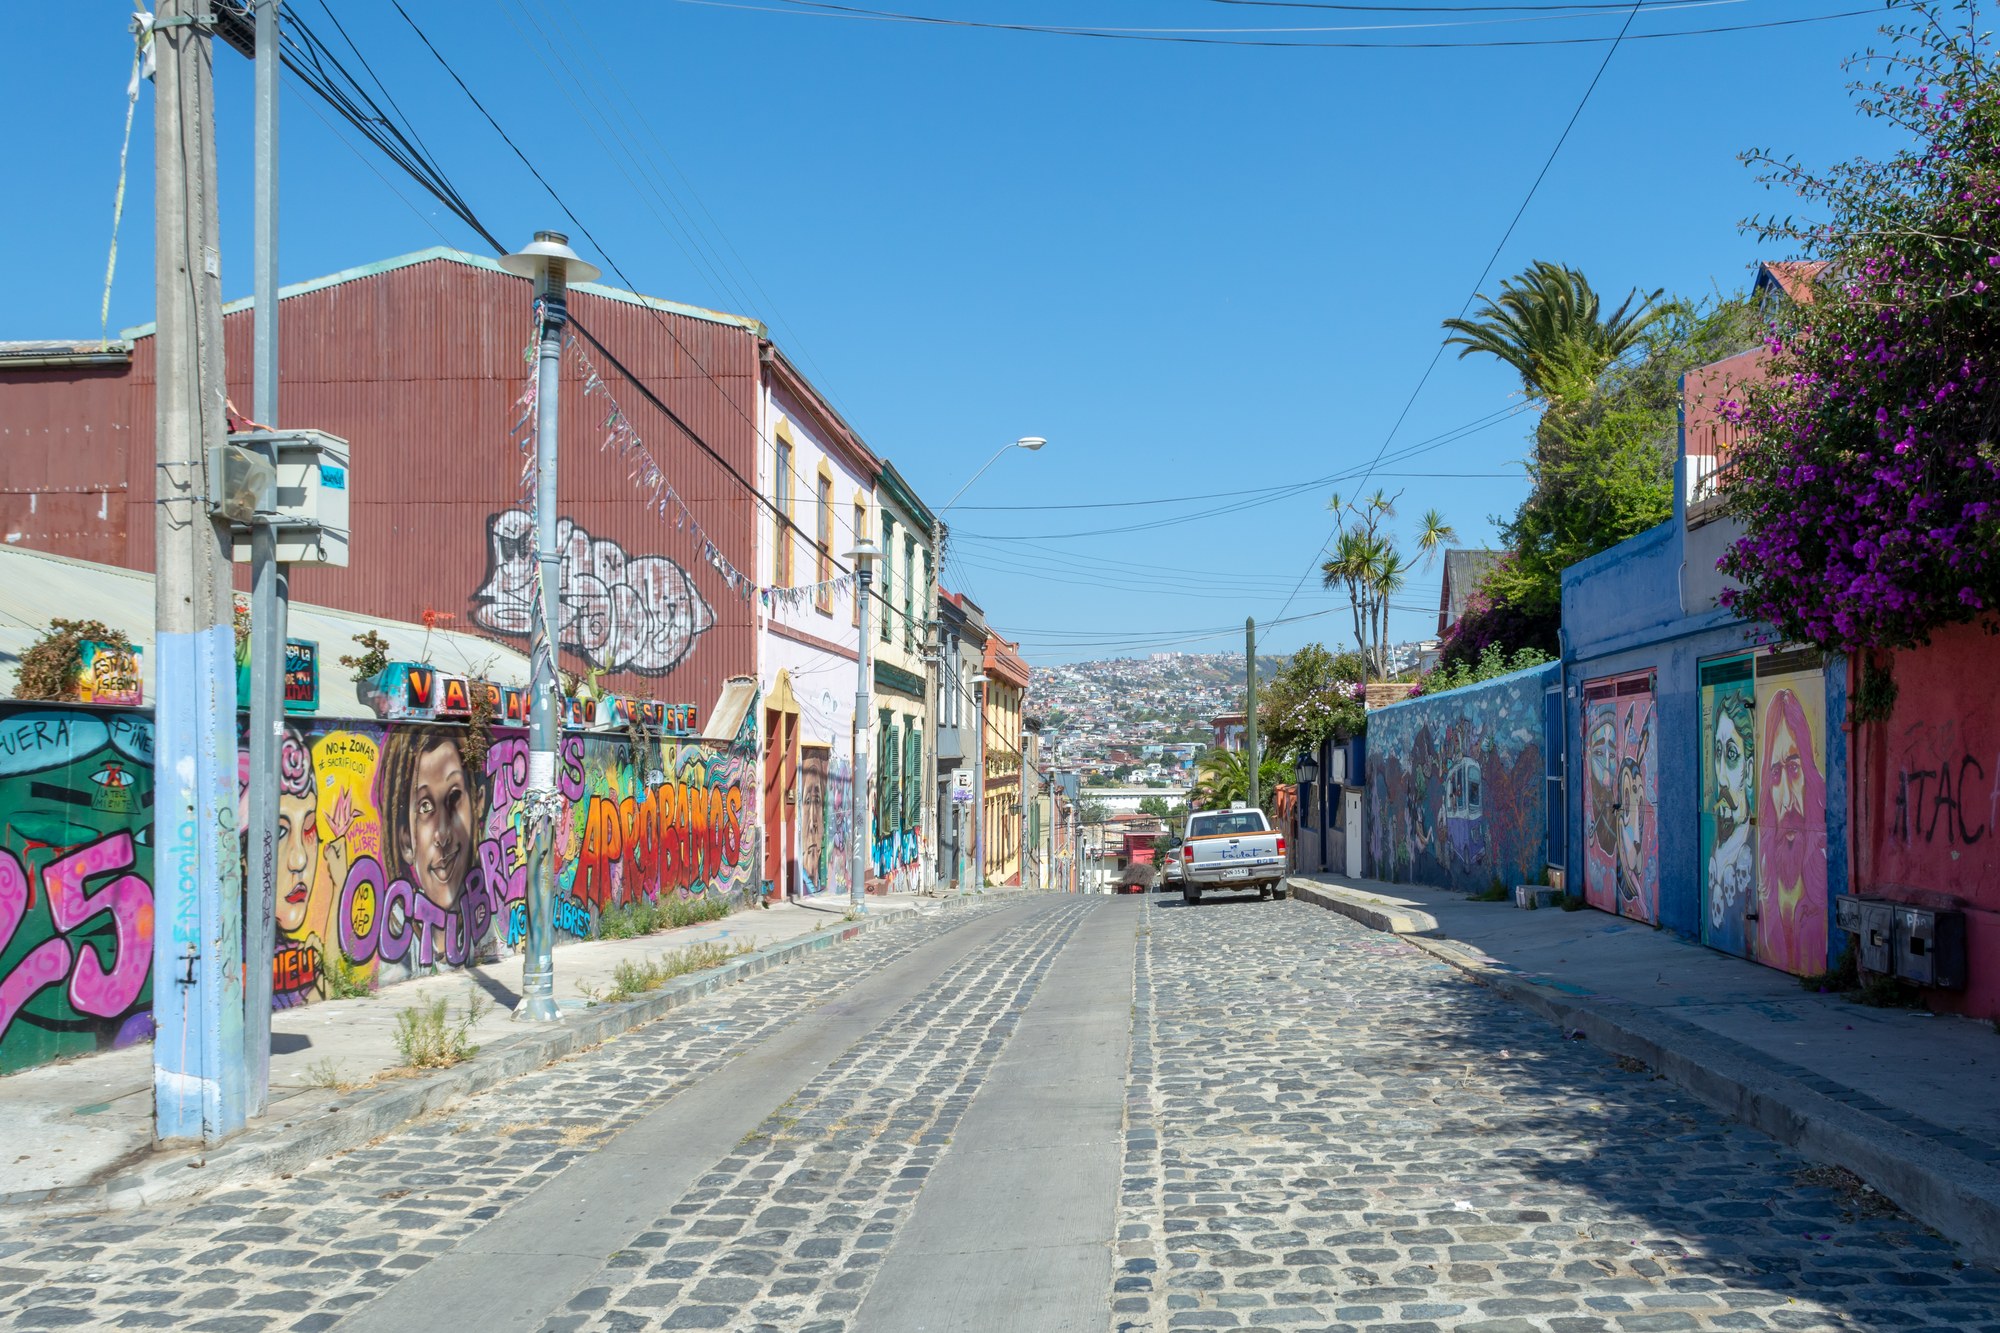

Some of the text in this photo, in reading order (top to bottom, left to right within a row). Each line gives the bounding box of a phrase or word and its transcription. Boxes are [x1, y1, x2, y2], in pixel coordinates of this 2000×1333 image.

[0, 718, 70, 756] UERA
[349, 739, 375, 762] ZONAS
[353, 835, 378, 855] LIBRE
[571, 782, 742, 914] APROBAMOS
[339, 827, 527, 966] OCTUBRE
[356, 887, 369, 904] NO
[352, 914, 370, 933] AFP
[553, 893, 592, 938] LiBRES
